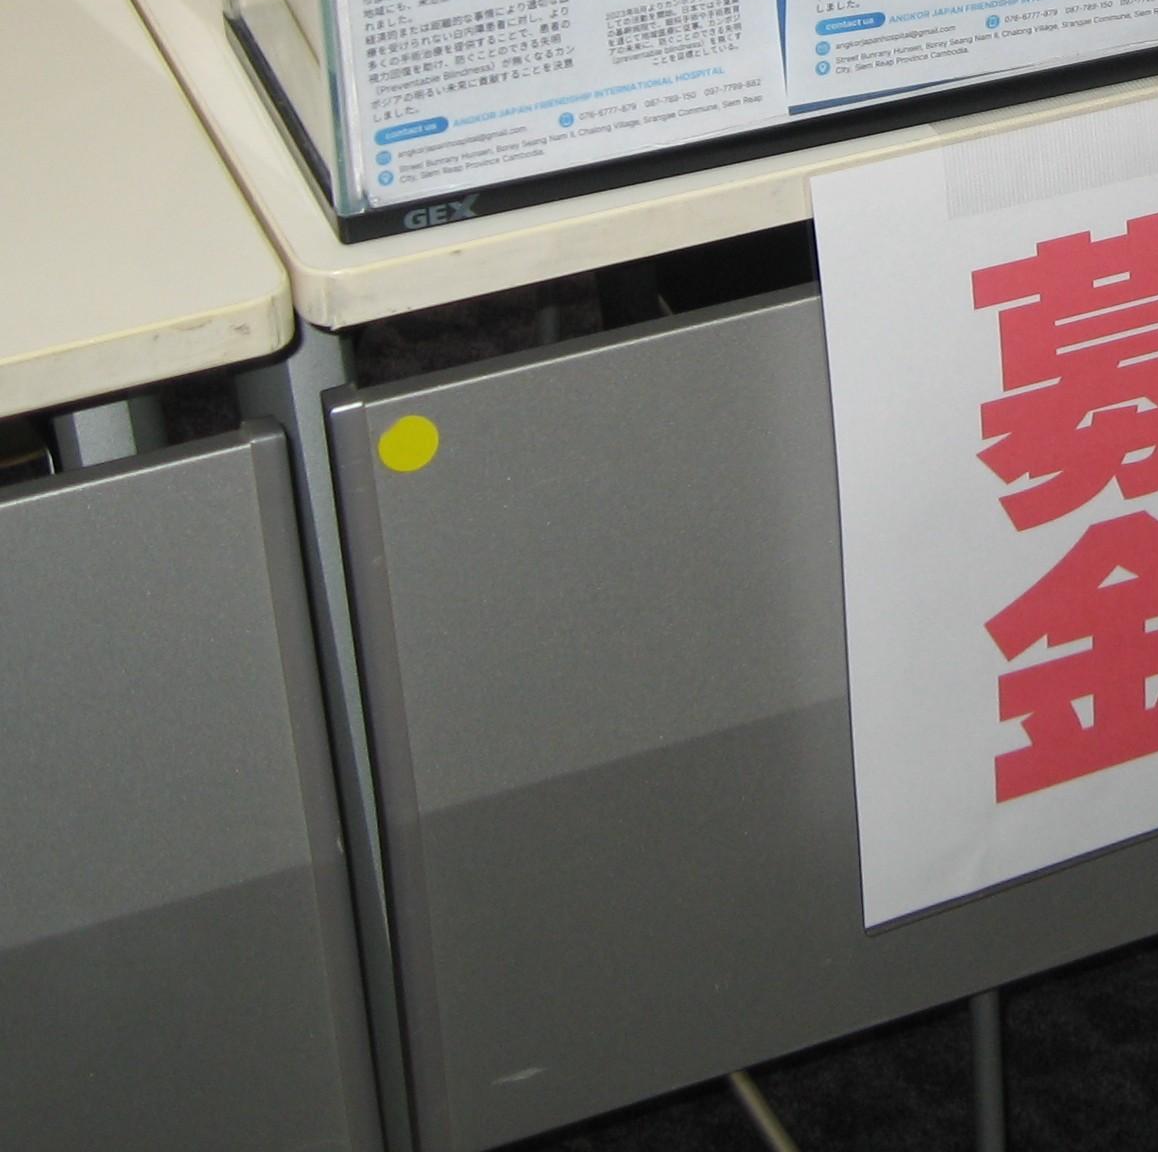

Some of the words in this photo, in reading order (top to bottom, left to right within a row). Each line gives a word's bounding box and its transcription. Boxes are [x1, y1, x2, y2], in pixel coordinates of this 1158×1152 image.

[817, 0, 861, 14] しました。
[403, 194, 481, 230] GEX
